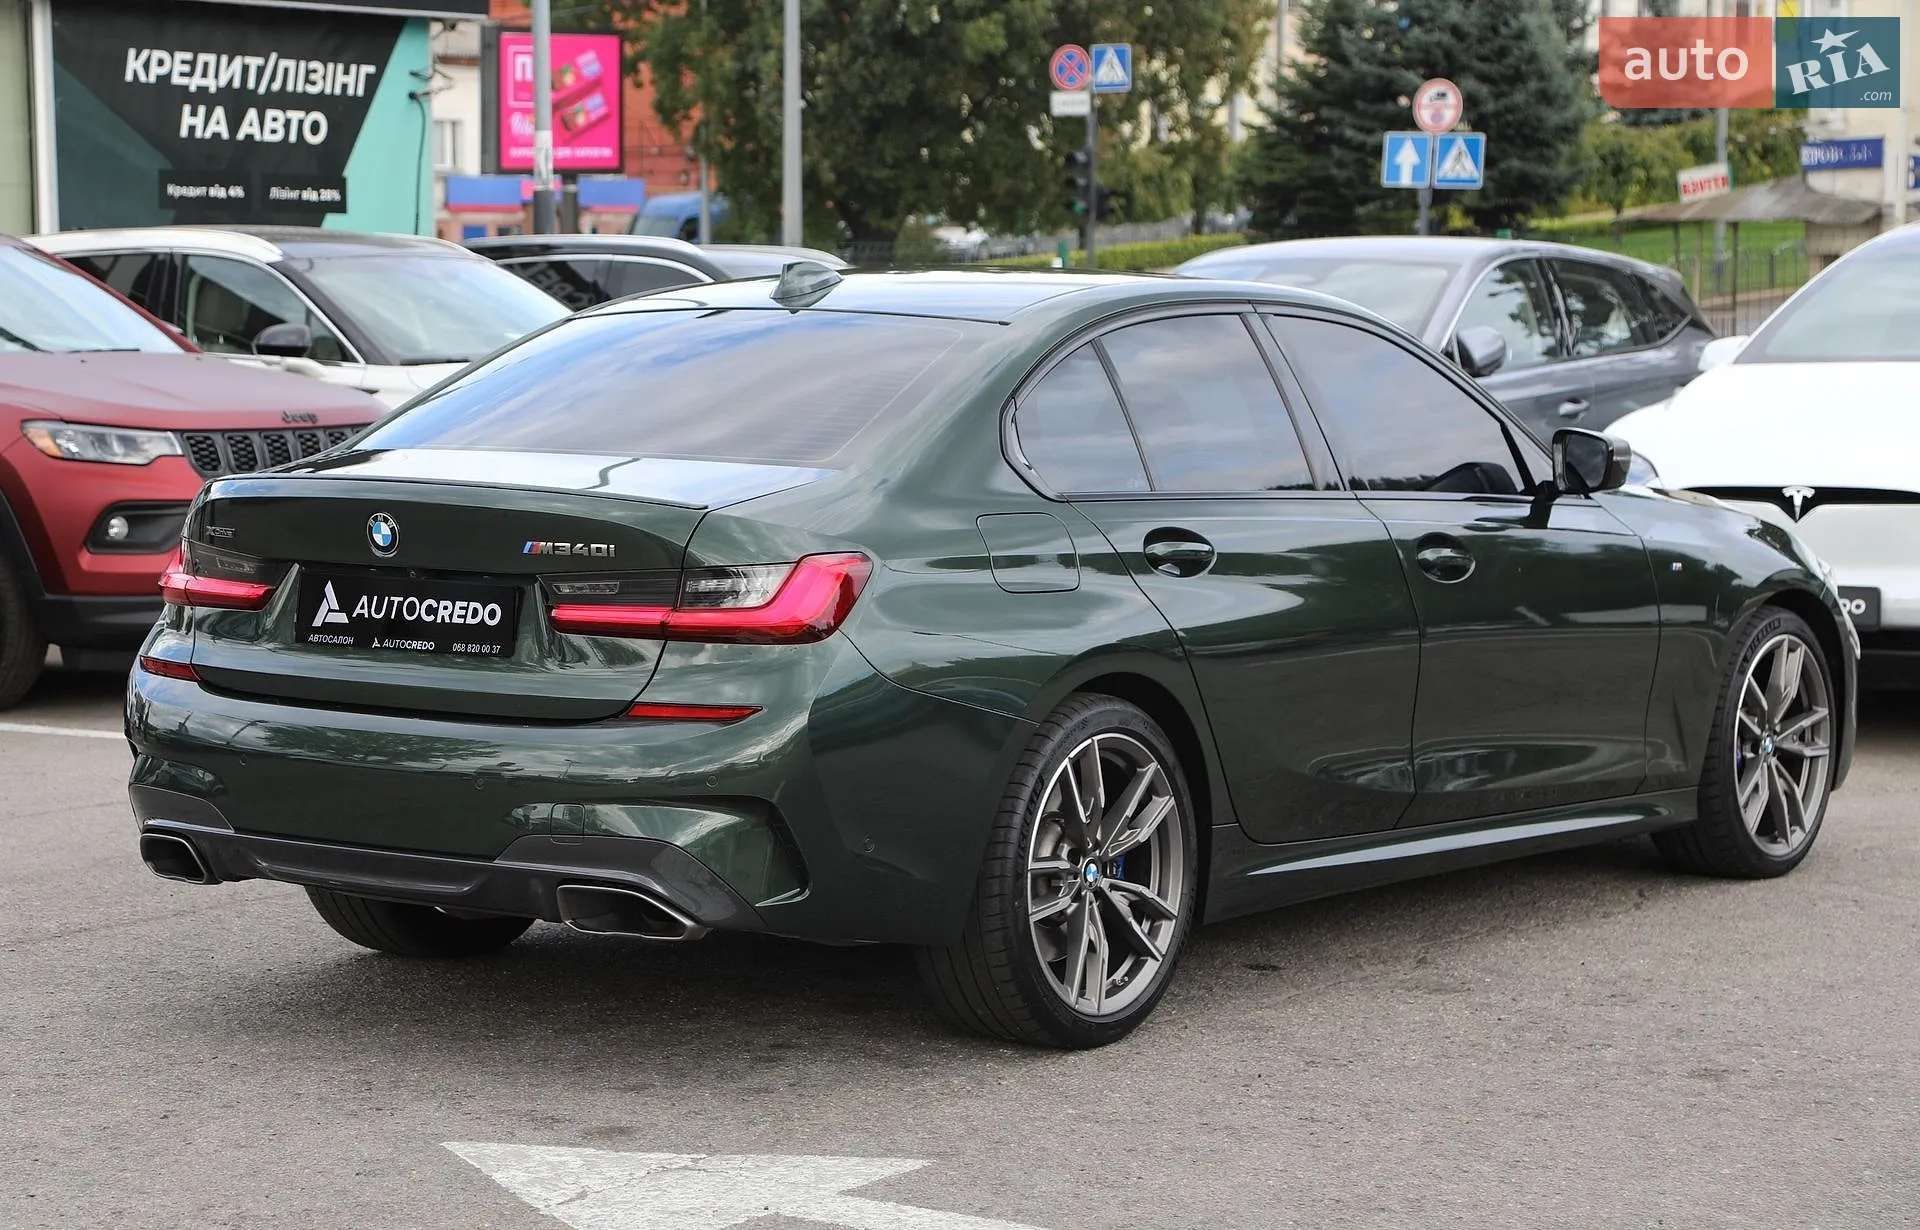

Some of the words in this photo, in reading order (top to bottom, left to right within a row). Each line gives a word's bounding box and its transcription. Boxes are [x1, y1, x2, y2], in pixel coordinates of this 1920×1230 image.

[123, 47, 377, 98] КРЕДИТ/ЛІЗІНГ
[178, 103, 230, 141] НА
[235, 106, 329, 146] АВТО
[166, 183, 207, 200] Кредит
[281, 409, 319, 425] Jeep
[351, 594, 502, 627] AUTOCREDO
[307, 633, 355, 645] АВТОСАЛОН
[382, 638, 436, 651] AUTOCREDO
[452, 643, 466, 652] 068
[467, 644, 480, 653] 820
[481, 645, 491, 654] 00
[491, 645, 501, 654] 37
